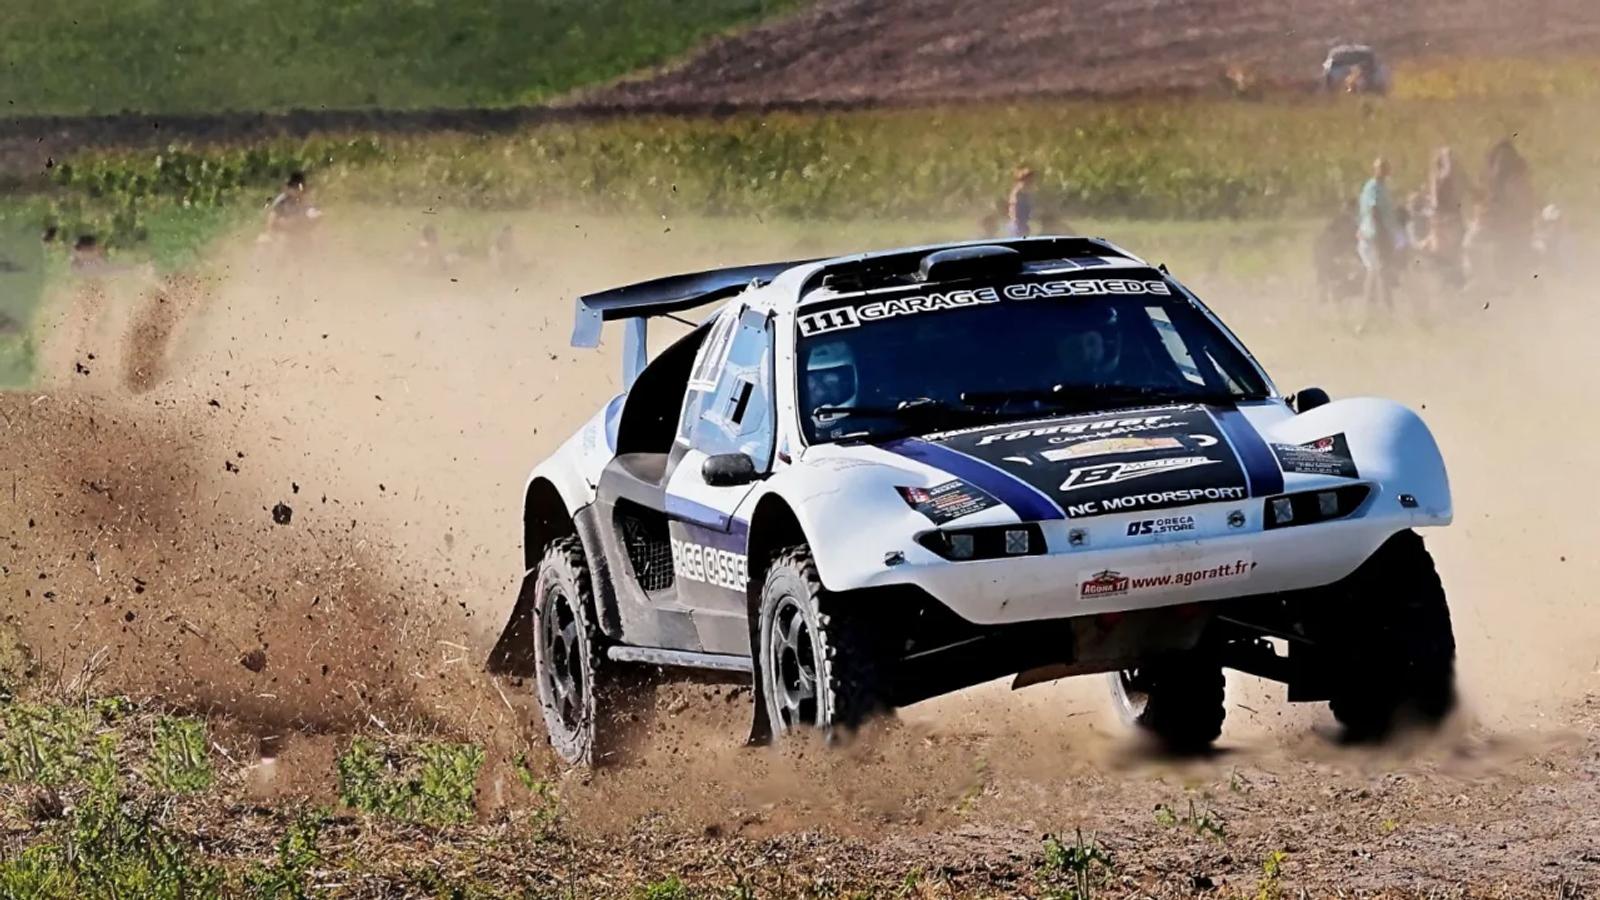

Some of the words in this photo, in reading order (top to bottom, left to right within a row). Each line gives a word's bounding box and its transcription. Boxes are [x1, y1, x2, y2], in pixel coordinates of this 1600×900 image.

[802, 309, 854, 334] 111
[857, 288, 1000, 321] GARAGE
[1003, 279, 1171, 300] CASSIEDE
[1067, 502, 1098, 517] NC
[1102, 486, 1245, 511] MOTORSPORT
[1156, 516, 1195, 526] ORECA
[1132, 560, 1249, 589] www.agoratt.fr
